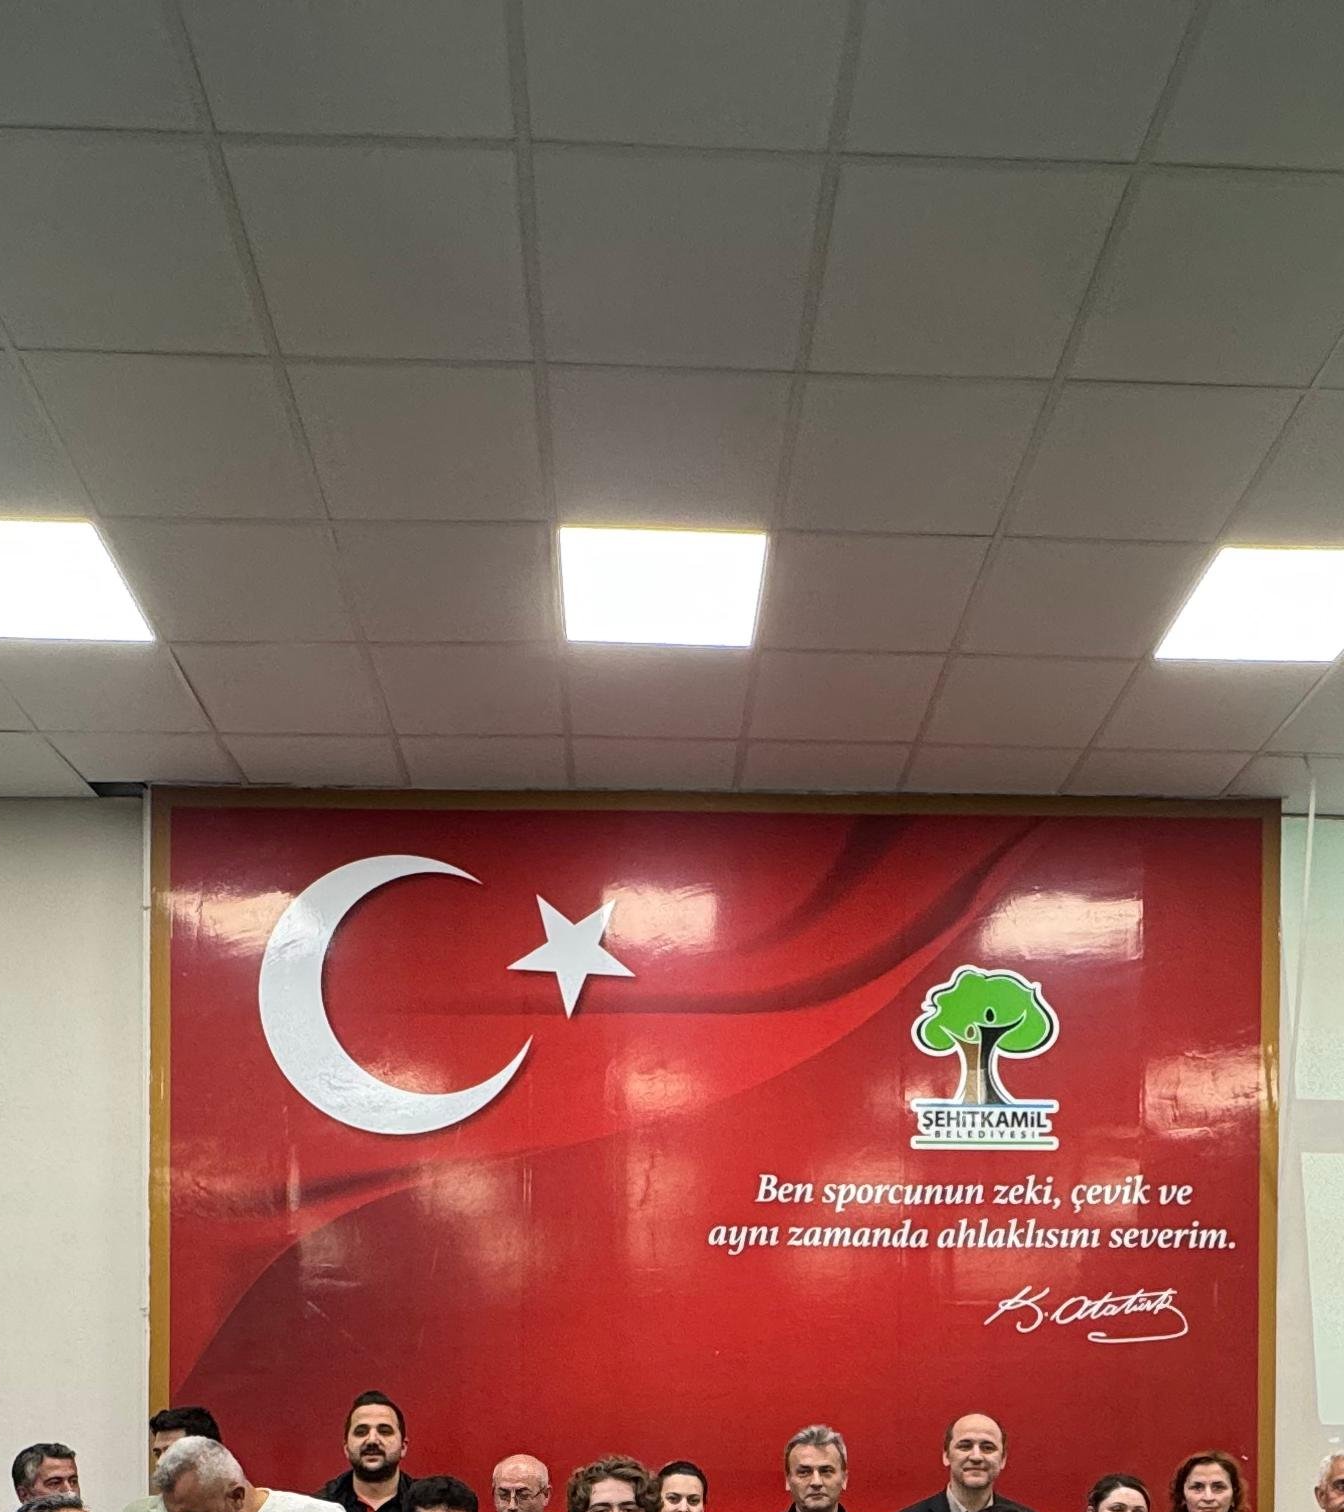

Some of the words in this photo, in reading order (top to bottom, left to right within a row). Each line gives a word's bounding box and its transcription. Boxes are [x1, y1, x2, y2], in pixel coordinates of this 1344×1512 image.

[755, 1173, 814, 1204] Ben
[821, 1181, 984, 1214] sporcunun
[992, 1174, 1062, 1210] zeki,
[1071, 1174, 1151, 1214] çevik
[1157, 1183, 1193, 1206] ve
[708, 1223, 779, 1256] aynı
[787, 1219, 929, 1250] zamanda
[936, 1218, 1101, 1250] ahlaklısını
[1108, 1220, 1236, 1250] severim.
